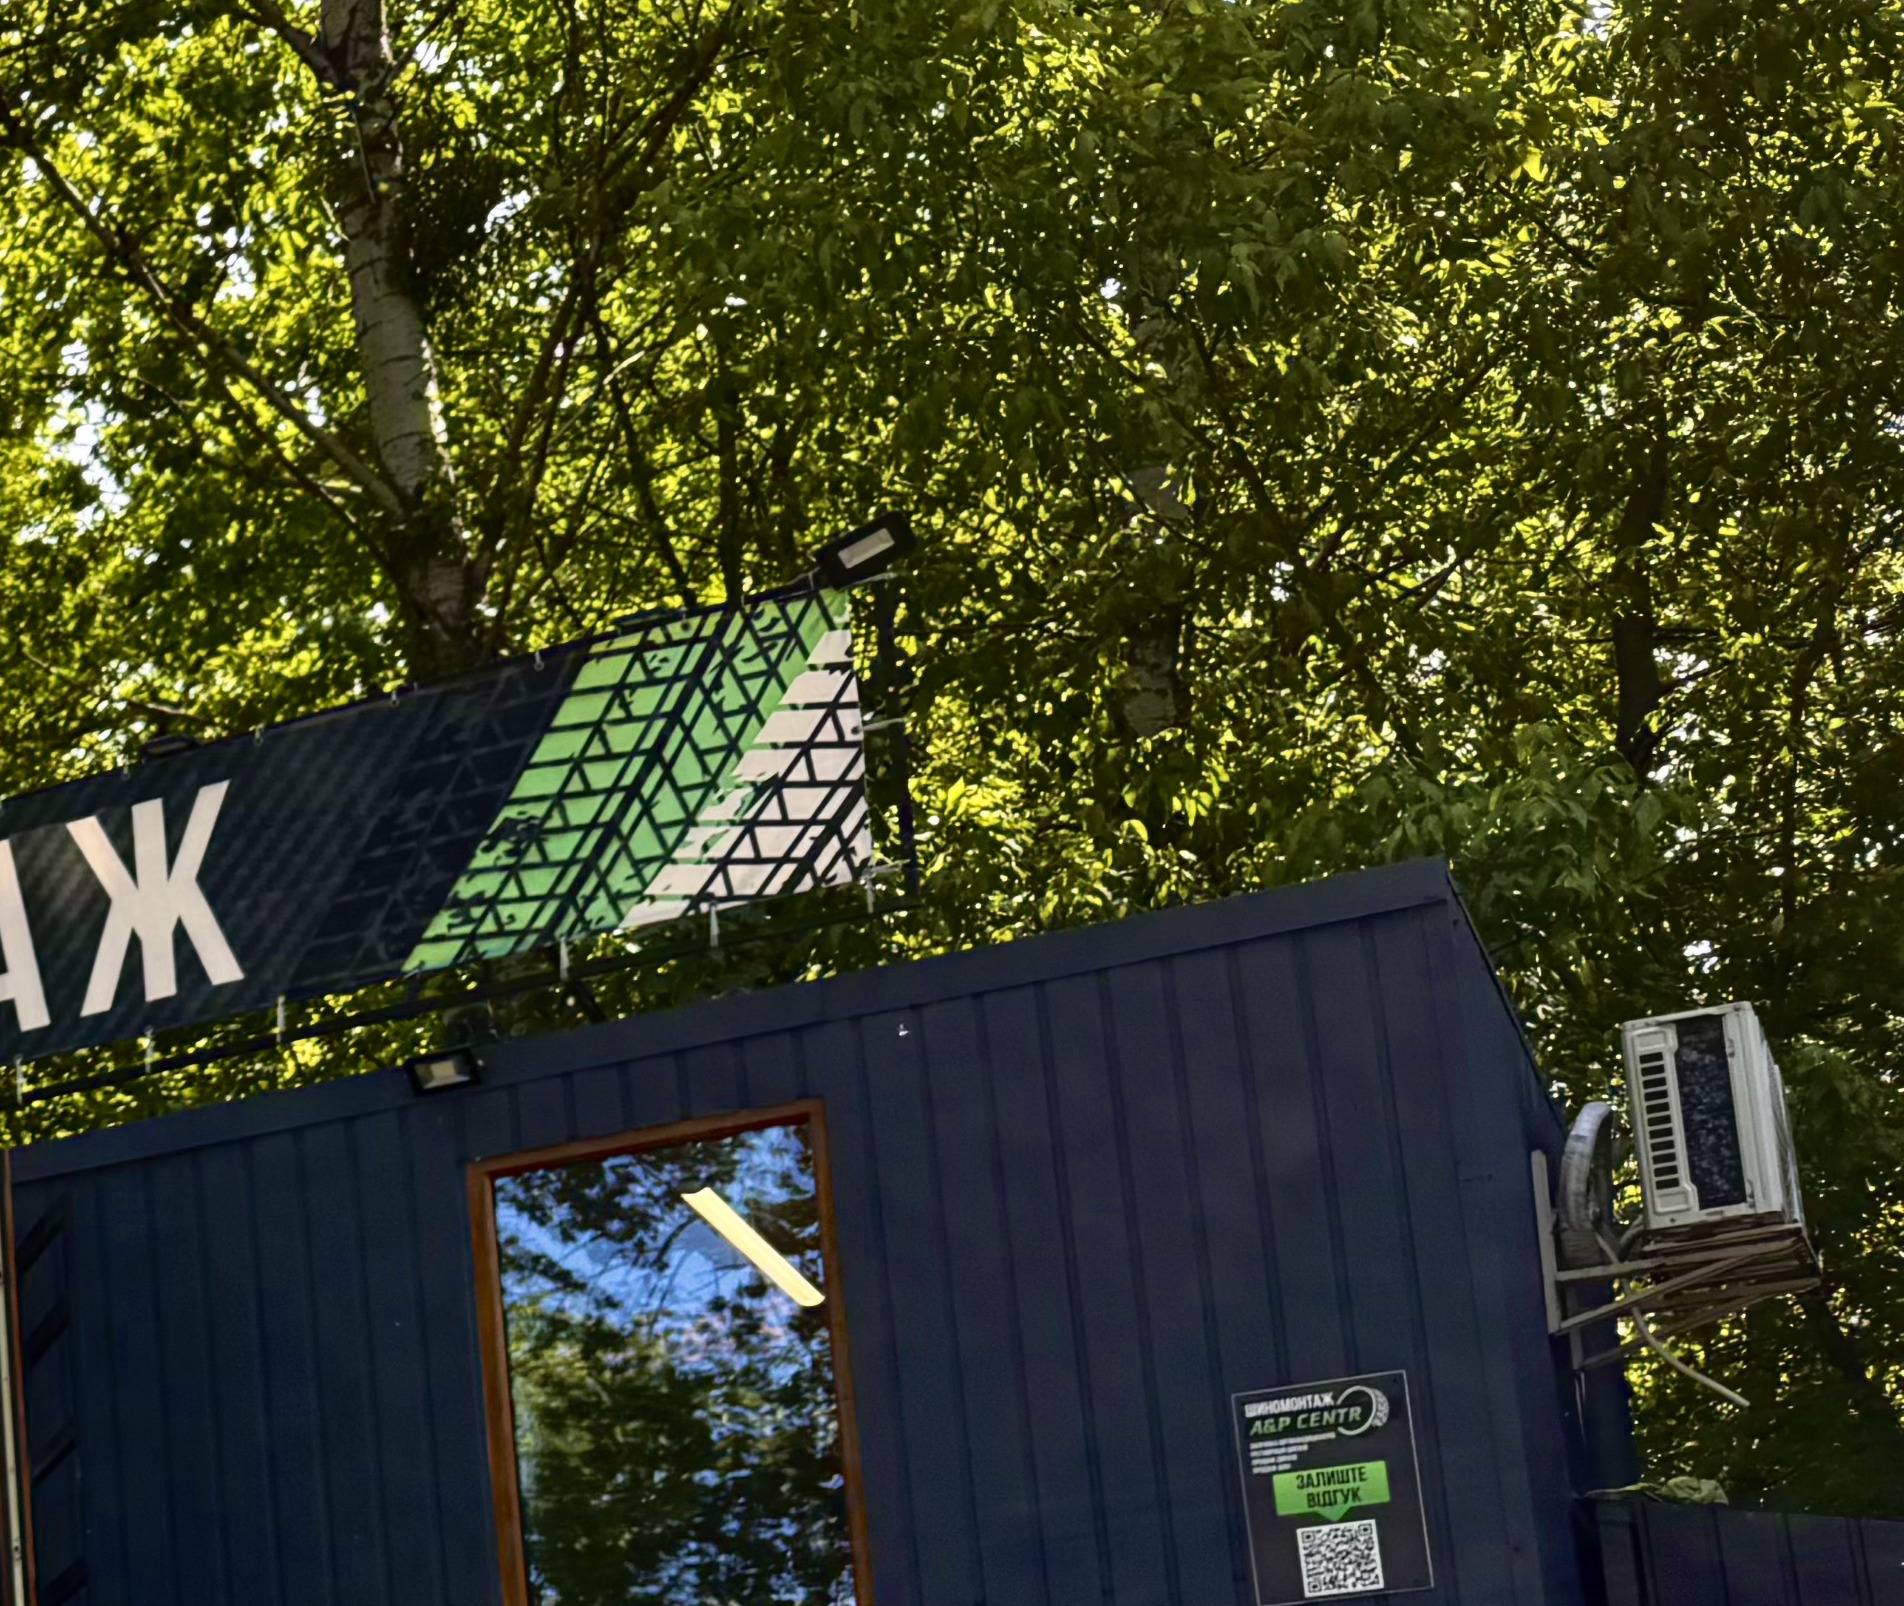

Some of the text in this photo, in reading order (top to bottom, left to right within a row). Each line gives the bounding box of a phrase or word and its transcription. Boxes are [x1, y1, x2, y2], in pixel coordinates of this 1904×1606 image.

[1244, 1391, 1334, 1418] ШИНОМОНТАЖ
[1249, 1406, 1362, 1436] A&P CENTR
[1296, 1466, 1367, 1489] ЗАЛИШТЕ
[1307, 1487, 1361, 1509] ВІДГУК
